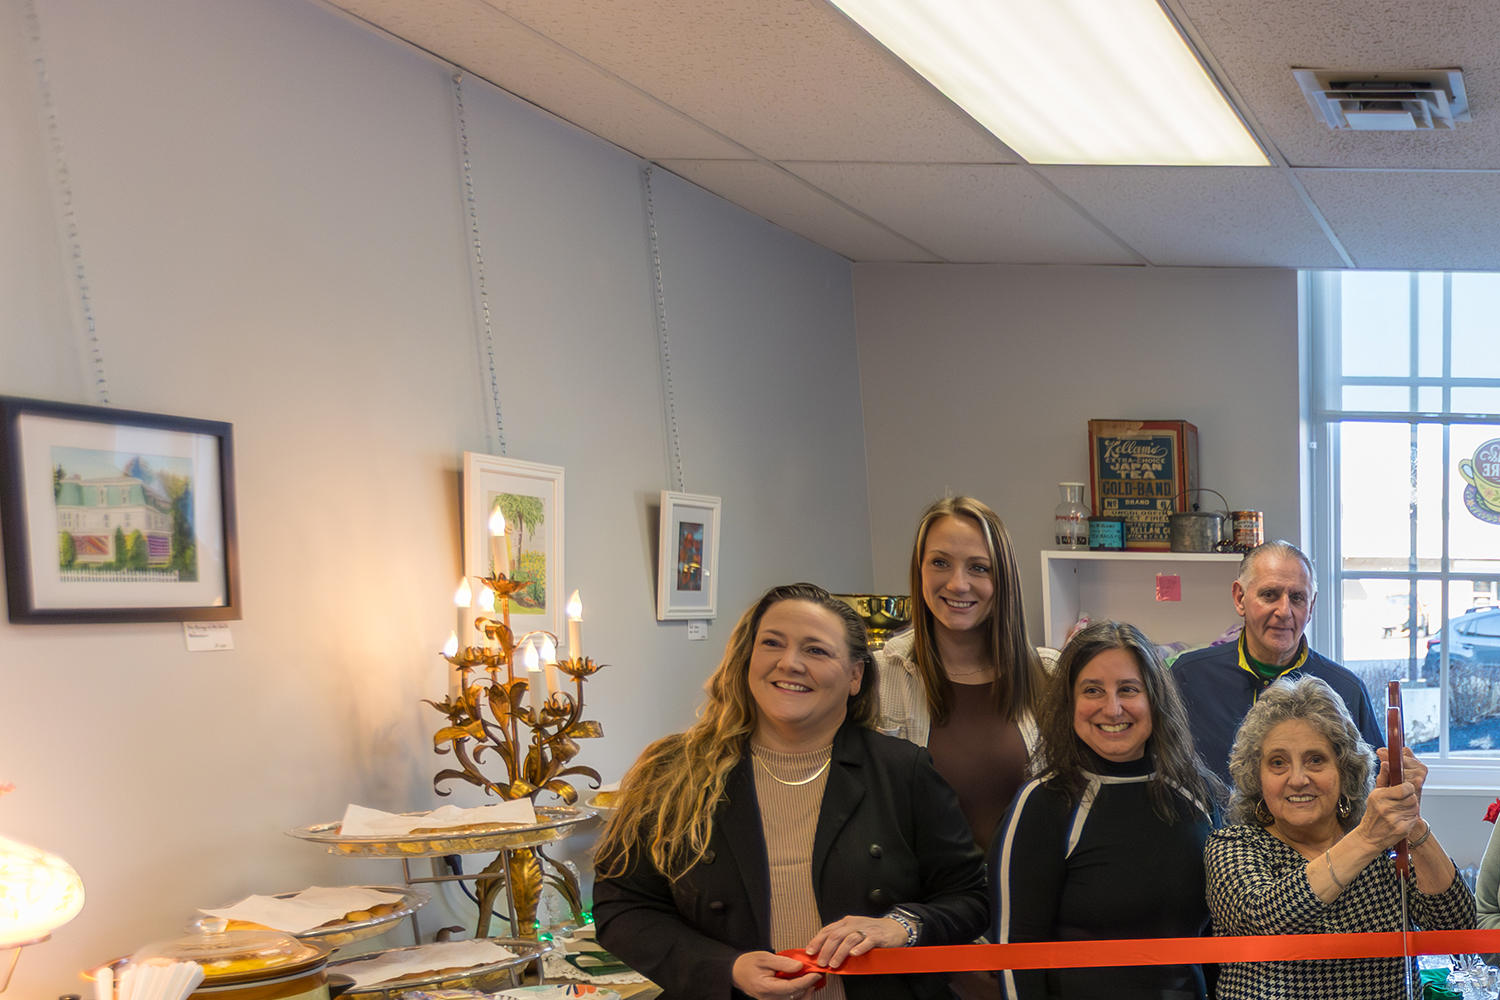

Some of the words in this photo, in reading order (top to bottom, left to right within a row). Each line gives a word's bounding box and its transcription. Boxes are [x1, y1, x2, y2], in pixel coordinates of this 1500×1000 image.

[1110, 463, 1162, 472] JAPAN
[1117, 470, 1156, 480] TEA
[1102, 481, 1171, 497] GOLD-BAND
